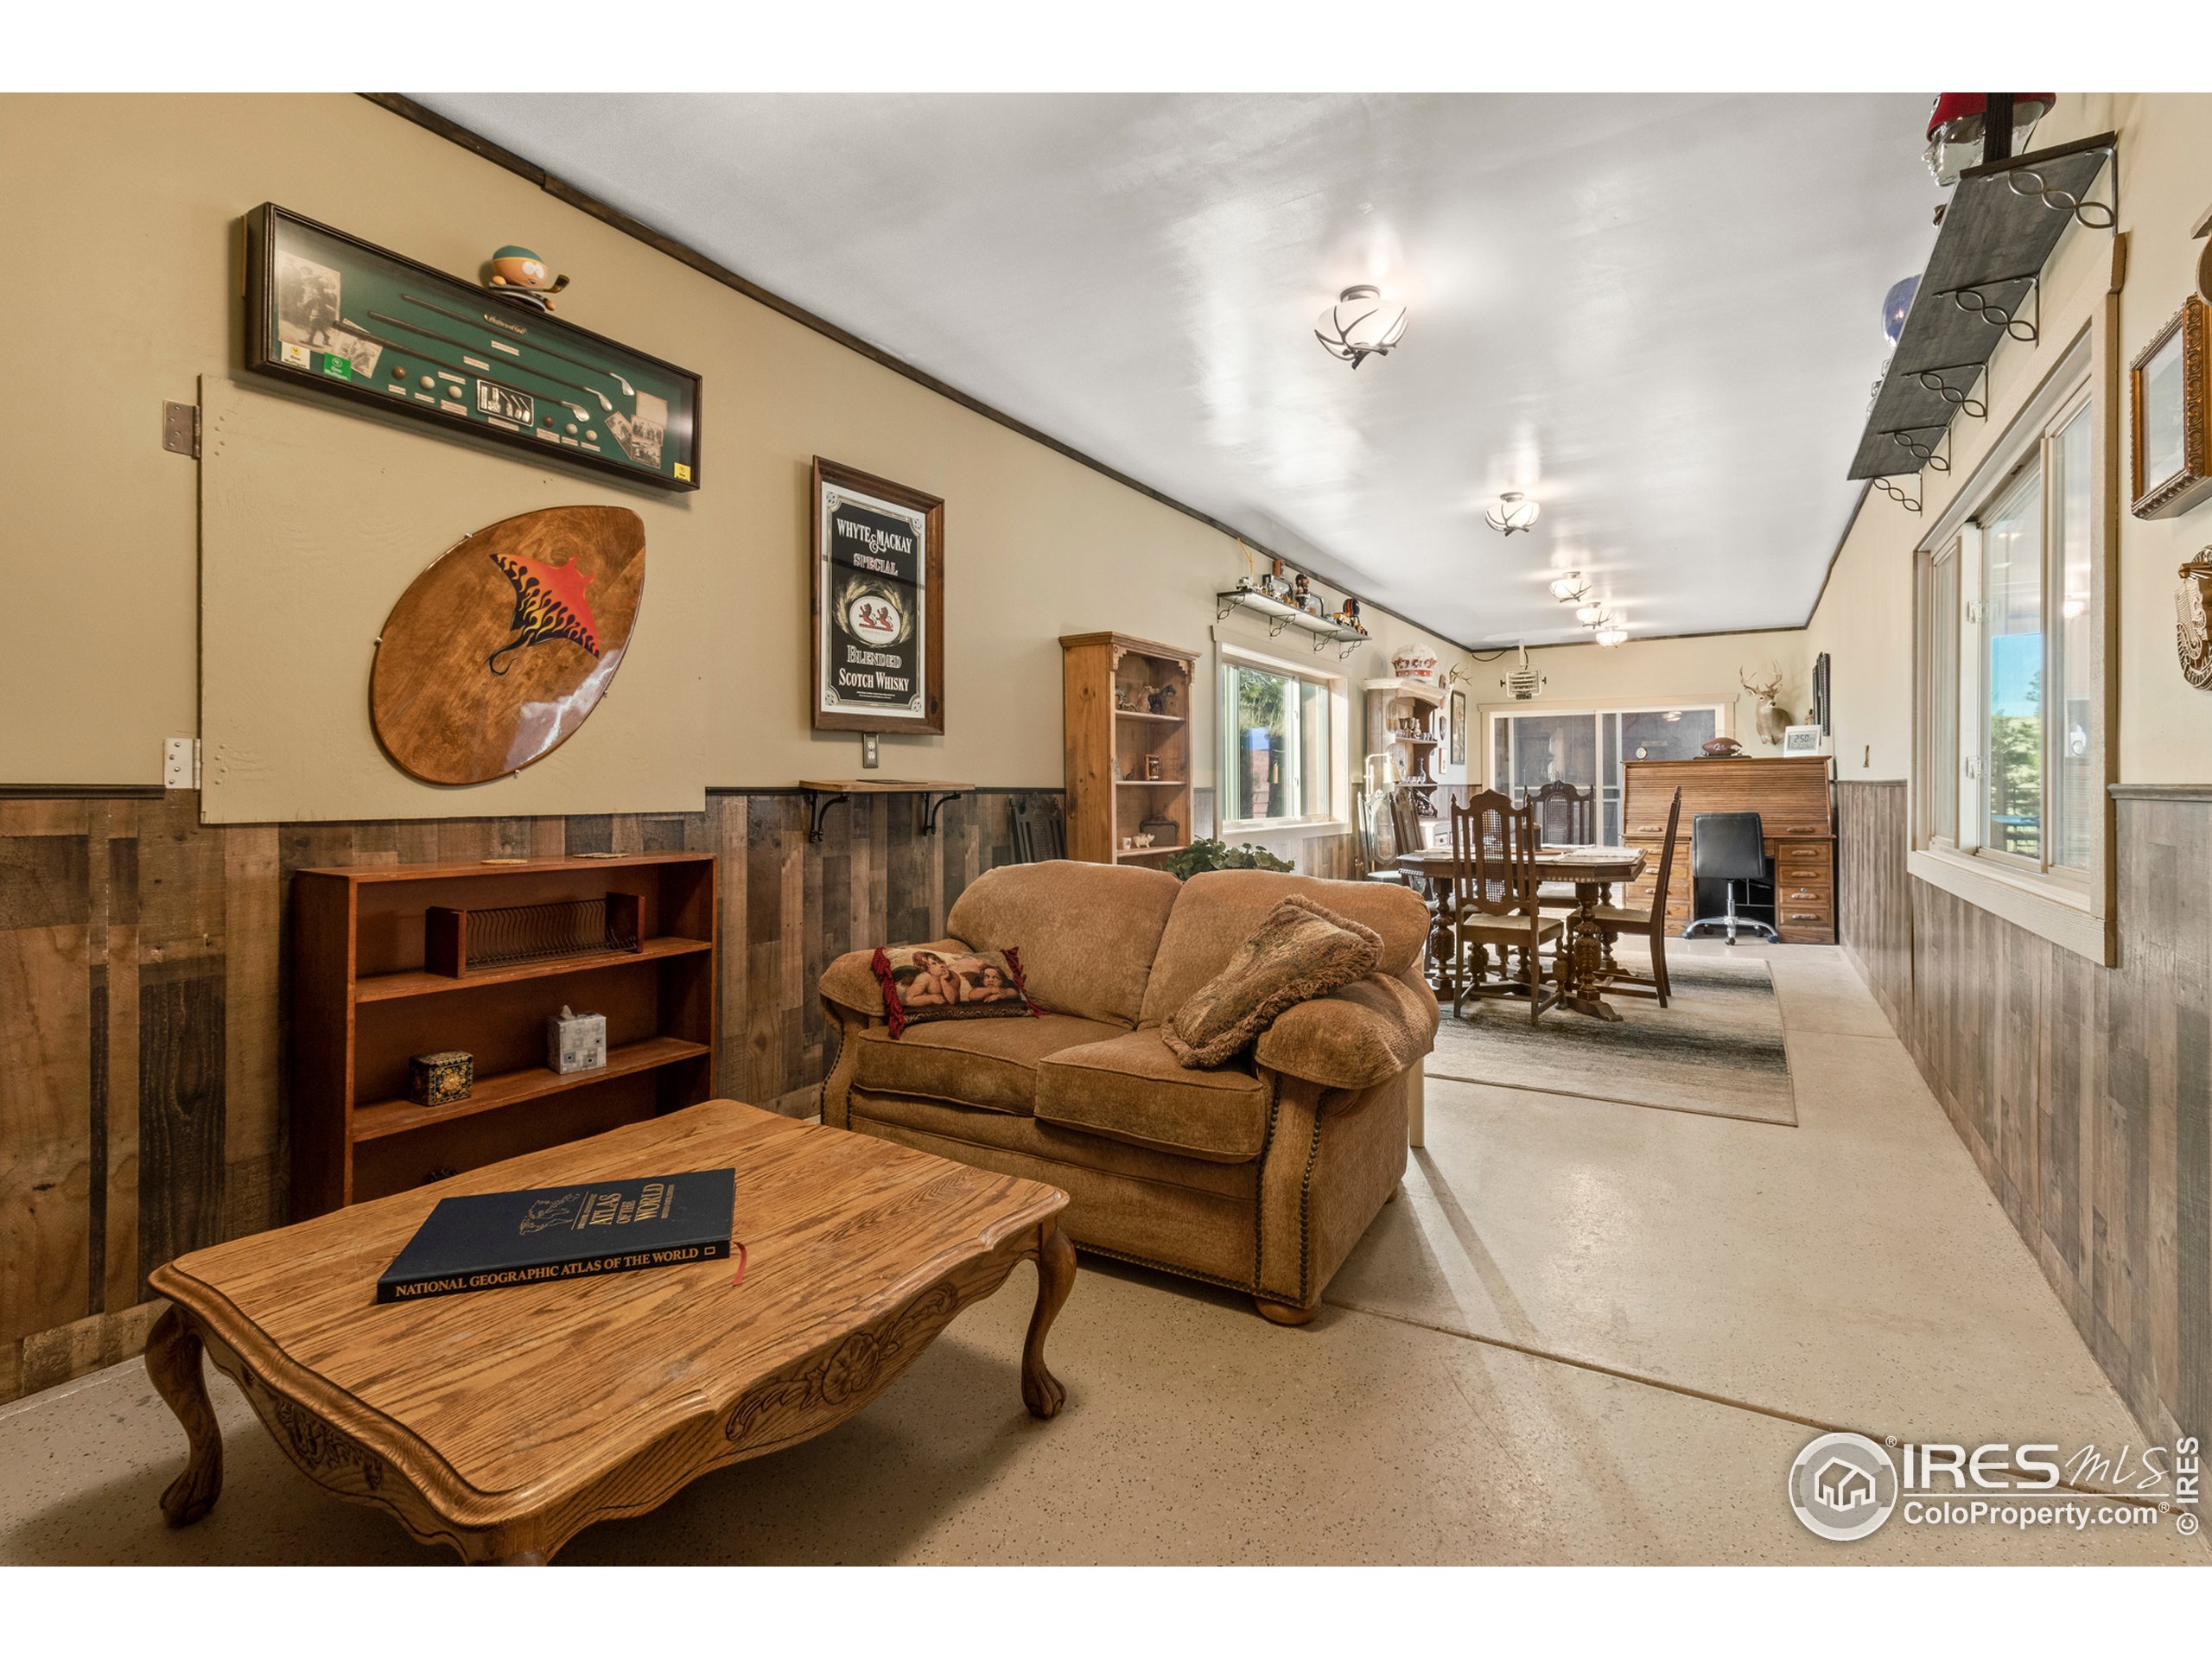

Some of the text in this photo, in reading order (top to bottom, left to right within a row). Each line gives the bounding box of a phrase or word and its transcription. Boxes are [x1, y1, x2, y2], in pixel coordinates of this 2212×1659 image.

[836, 518, 912, 554] WHYTE & MACKAY
[853, 553, 899, 576] SPECIAL
[847, 645, 903, 669] BLENDED
[838, 668, 910, 691] SCOTCH WHISKY
[589, 1193, 621, 1224] ATLAS
[634, 1184, 664, 1223] WORLD
[395, 1248, 699, 1296] NATIONAL GEOGRAPHIC ATLAS OF THE WORLD
